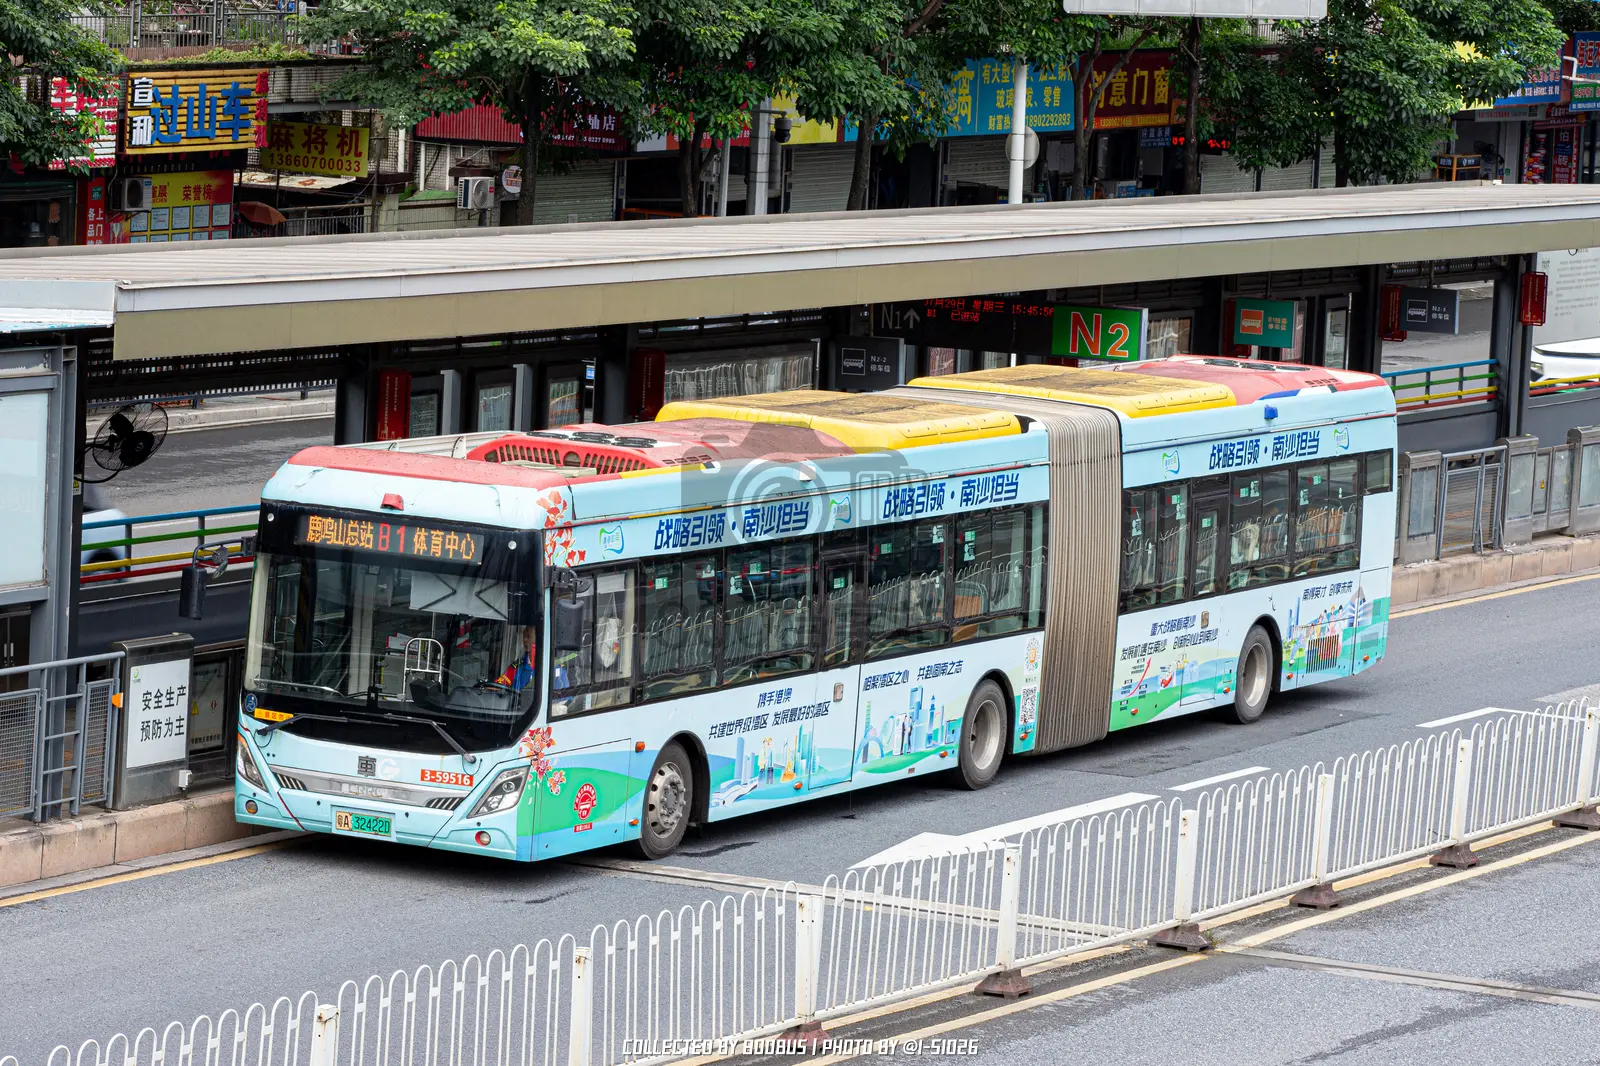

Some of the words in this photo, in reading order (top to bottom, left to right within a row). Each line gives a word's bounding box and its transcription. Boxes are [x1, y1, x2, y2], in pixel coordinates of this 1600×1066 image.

[995, 86, 1061, 108] 玻璃发、零售
[132, 77, 153, 146] 宣和
[150, 81, 252, 144] 过山车
[988, 114, 1014, 131] 财富热
[267, 122, 363, 158] 麻将机
[267, 152, 361, 173] 13660700033
[182, 184, 213, 201] 荣誉榜
[881, 303, 902, 329] N1
[972, 299, 1005, 312] 星期三
[1069, 311, 1130, 358] N2
[306, 515, 374, 550] 鹿鸣山总站
[378, 522, 406, 553] B1
[413, 526, 476, 560] 体育中心
[142, 684, 187, 712] 安全生产
[757, 687, 793, 708] 携手港澳
[140, 715, 185, 742] 预防为主
[708, 713, 770, 740] 共建世界级湾区
[771, 700, 831, 727] 发展最好的湾区
[423, 769, 471, 786] 3-59516
